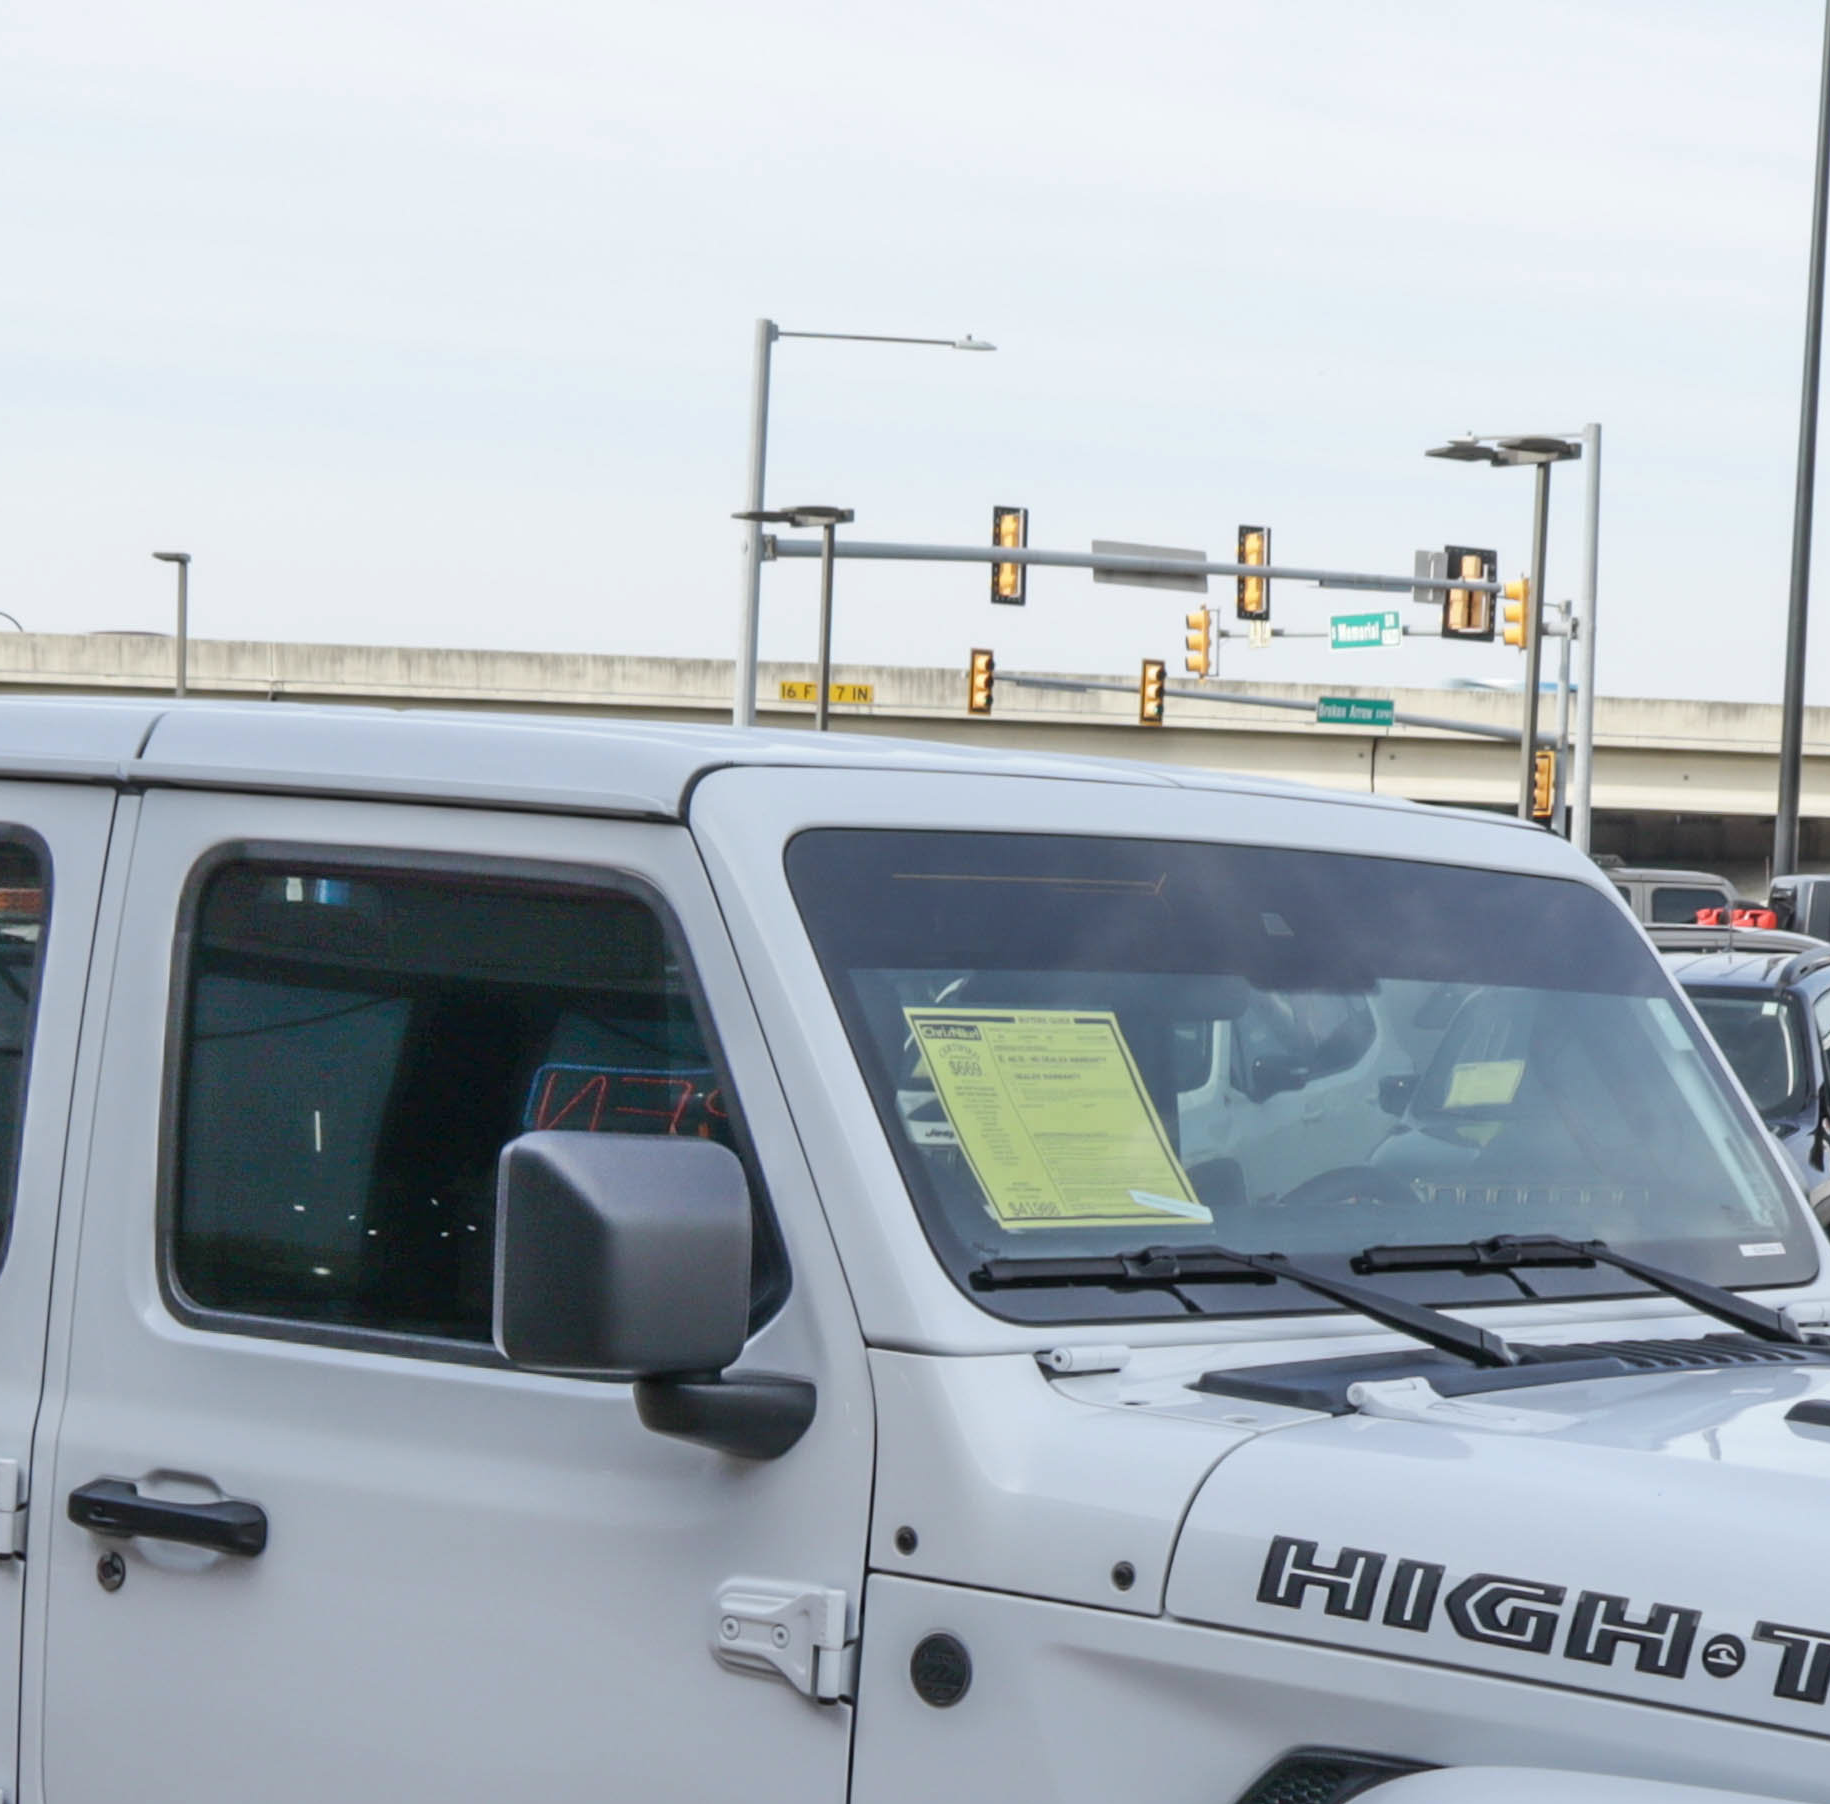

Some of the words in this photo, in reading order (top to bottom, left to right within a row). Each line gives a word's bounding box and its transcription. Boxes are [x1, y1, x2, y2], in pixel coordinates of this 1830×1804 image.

[1337, 621, 1380, 642] Memorial
[781, 682, 797, 699] 16
[835, 685, 846, 701] 7
[852, 687, 869, 701] IN
[1255, 1534, 1704, 1680] HIGH
